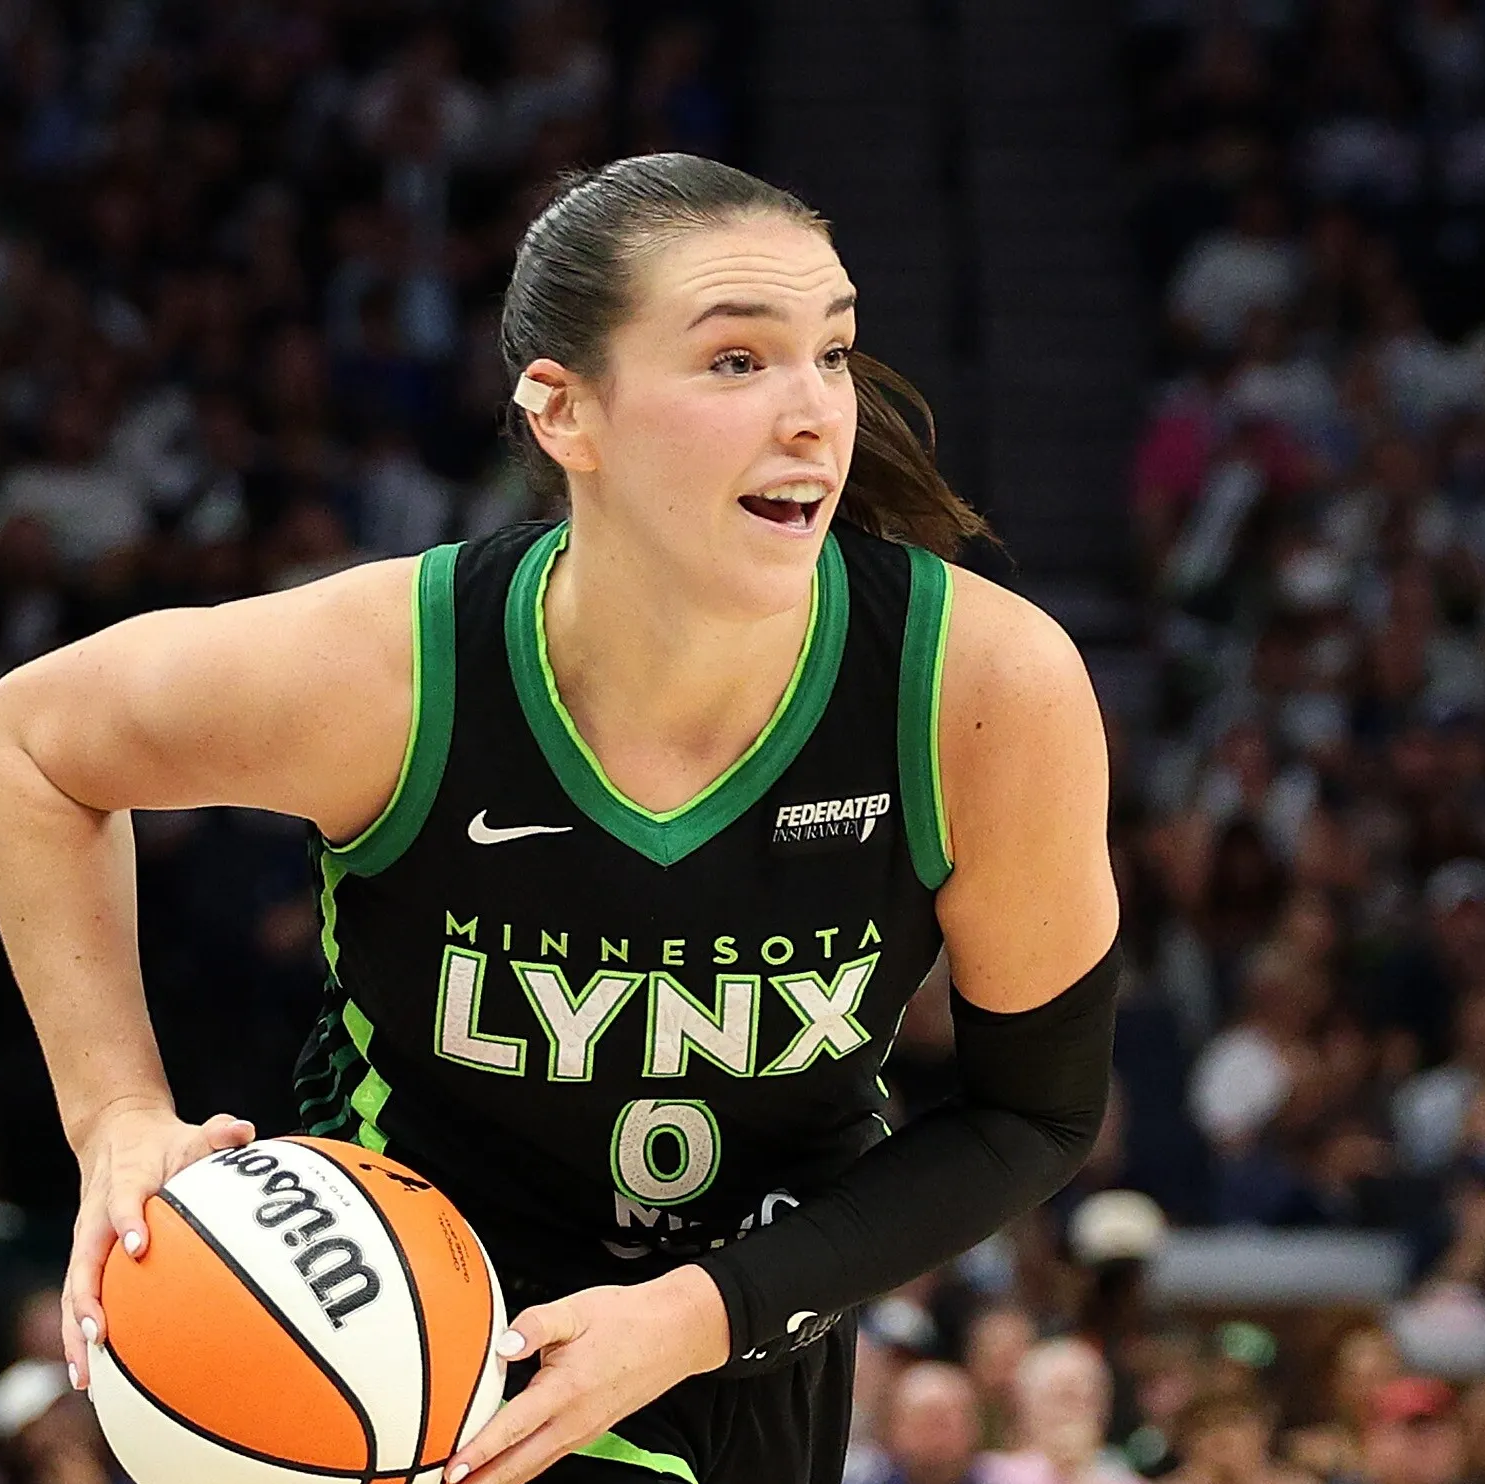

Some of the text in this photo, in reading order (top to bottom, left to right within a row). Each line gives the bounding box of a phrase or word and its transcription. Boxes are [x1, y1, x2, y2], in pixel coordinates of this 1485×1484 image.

[775, 793, 891, 828] FEDERATED
[444, 909, 883, 966] MINNESOTA
[434, 944, 882, 1083] LYNX
[209, 1145, 384, 1332] Wilson
